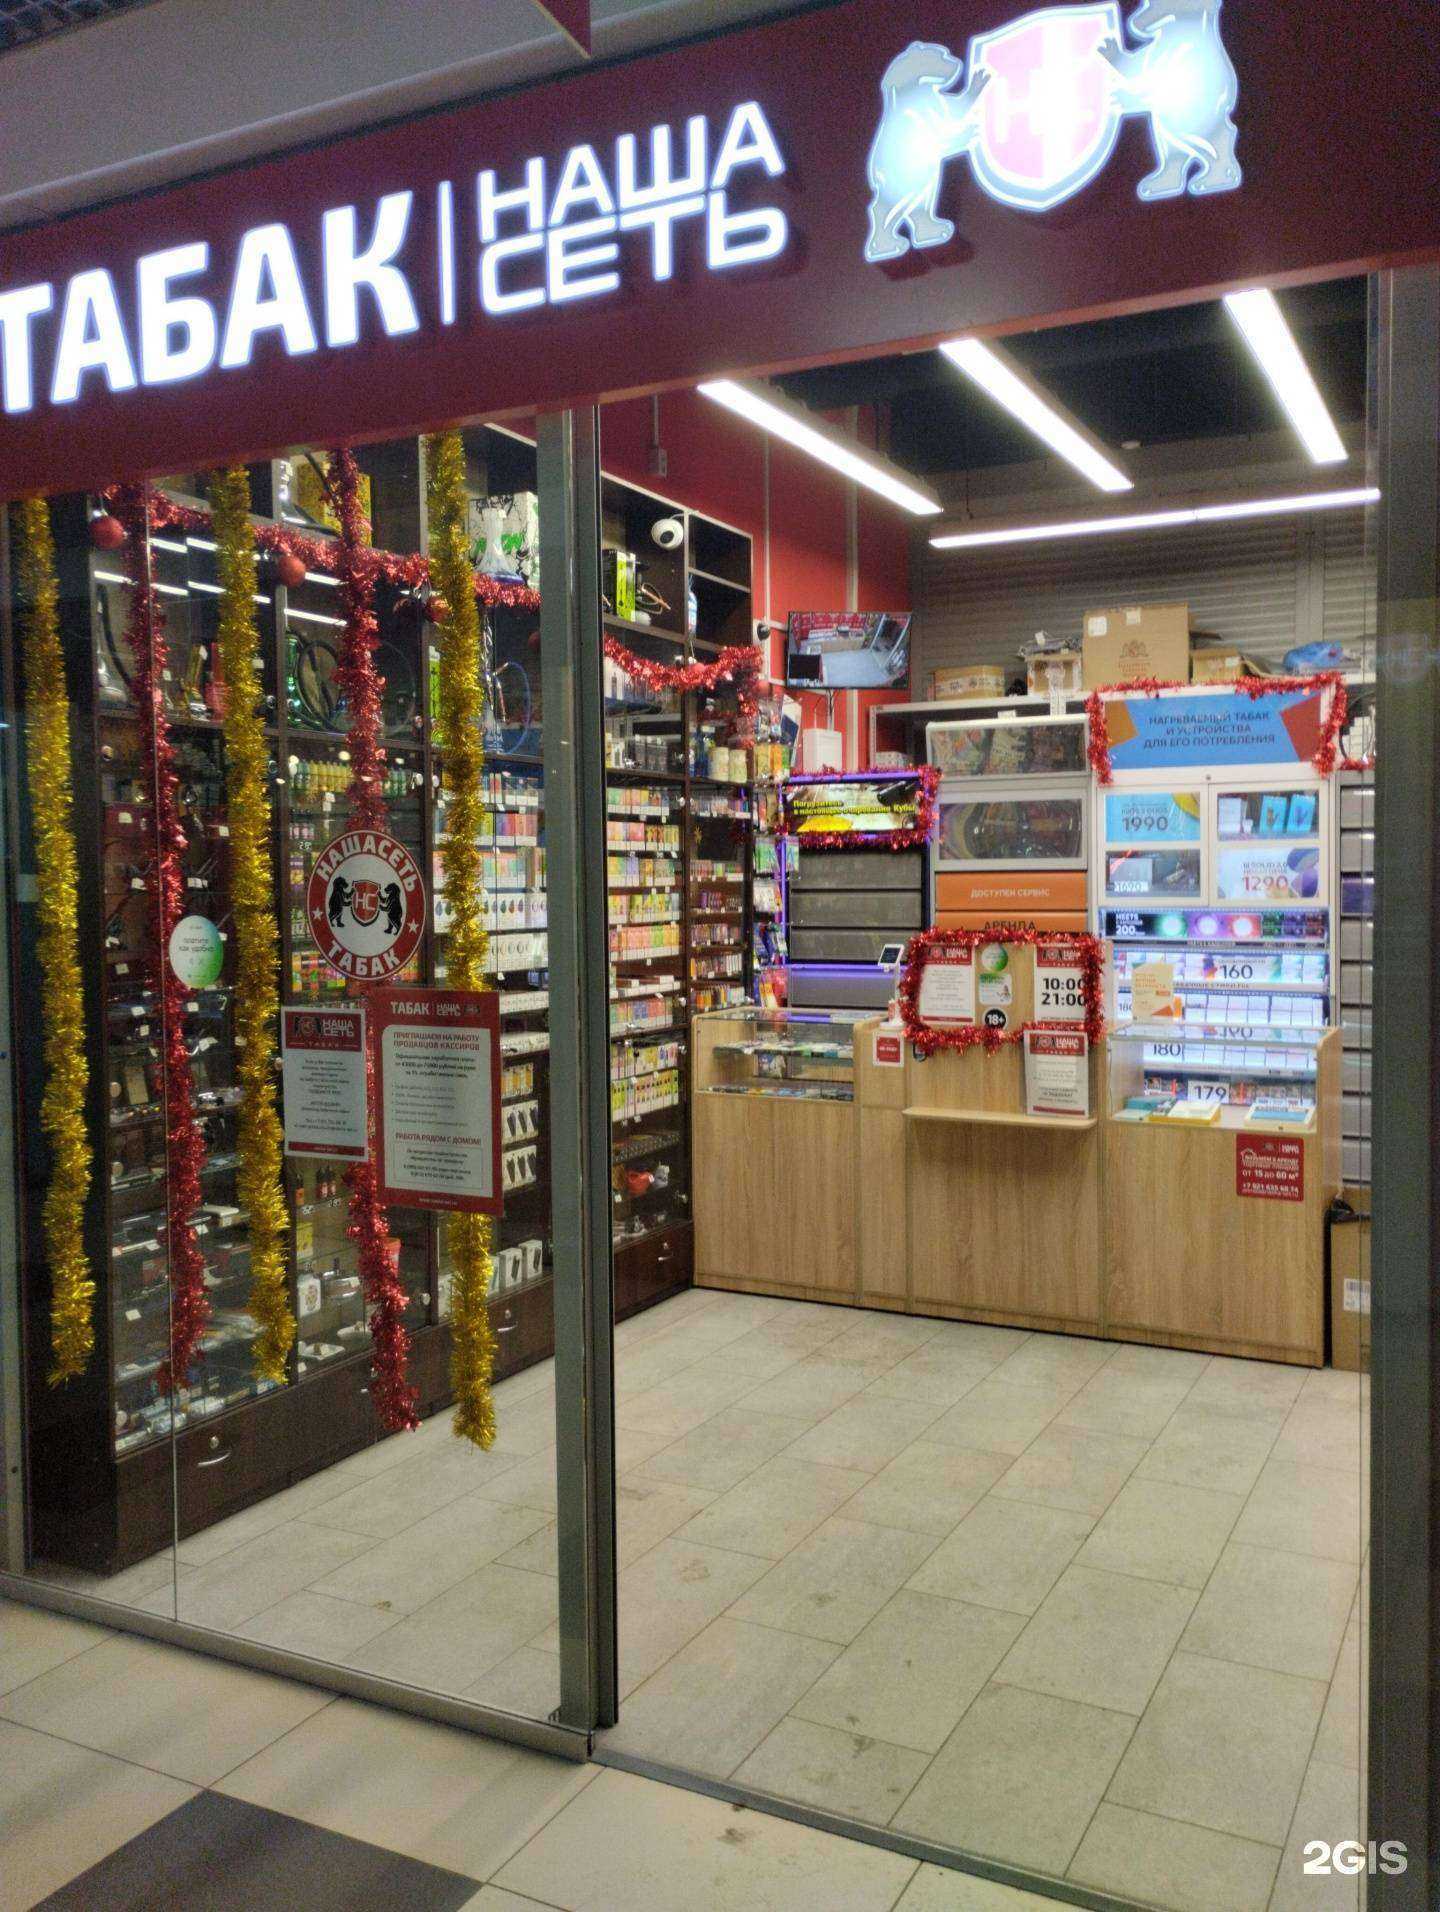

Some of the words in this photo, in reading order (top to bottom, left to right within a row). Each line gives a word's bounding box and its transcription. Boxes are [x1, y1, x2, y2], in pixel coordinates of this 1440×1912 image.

[477, 100, 785, 243] НАША
[478, 190, 788, 315] СЕТЬ
[0, 190, 420, 414] ТАБАК
[1235, 711, 1269, 721] ТАБАК
[1176, 723, 1252, 736] УСТРОЙСТВА
[1144, 738, 1167, 749] ДЛЯ
[1169, 738, 1191, 747] ЕГО
[1193, 734, 1275, 746] ПОТРЕБЛЕНИЯ
[1121, 816, 1169, 832] 1990
[1242, 876, 1289, 891] 1290
[1017, 887, 1050, 897] СЕРВИС
[984, 920, 1036, 930] АРЕНДА
[1115, 925, 1136, 936] 200
[328, 940, 402, 976] ТАБАК
[1219, 964, 1254, 979] 160
[1041, 992, 1087, 1007] 21:00
[390, 1001, 430, 1016] ТАБАК
[322, 1019, 354, 1029] НАША
[987, 1014, 1005, 1025] 18+
[323, 1027, 354, 1037] СЕТЬ
[1193, 1085, 1227, 1100] 179
